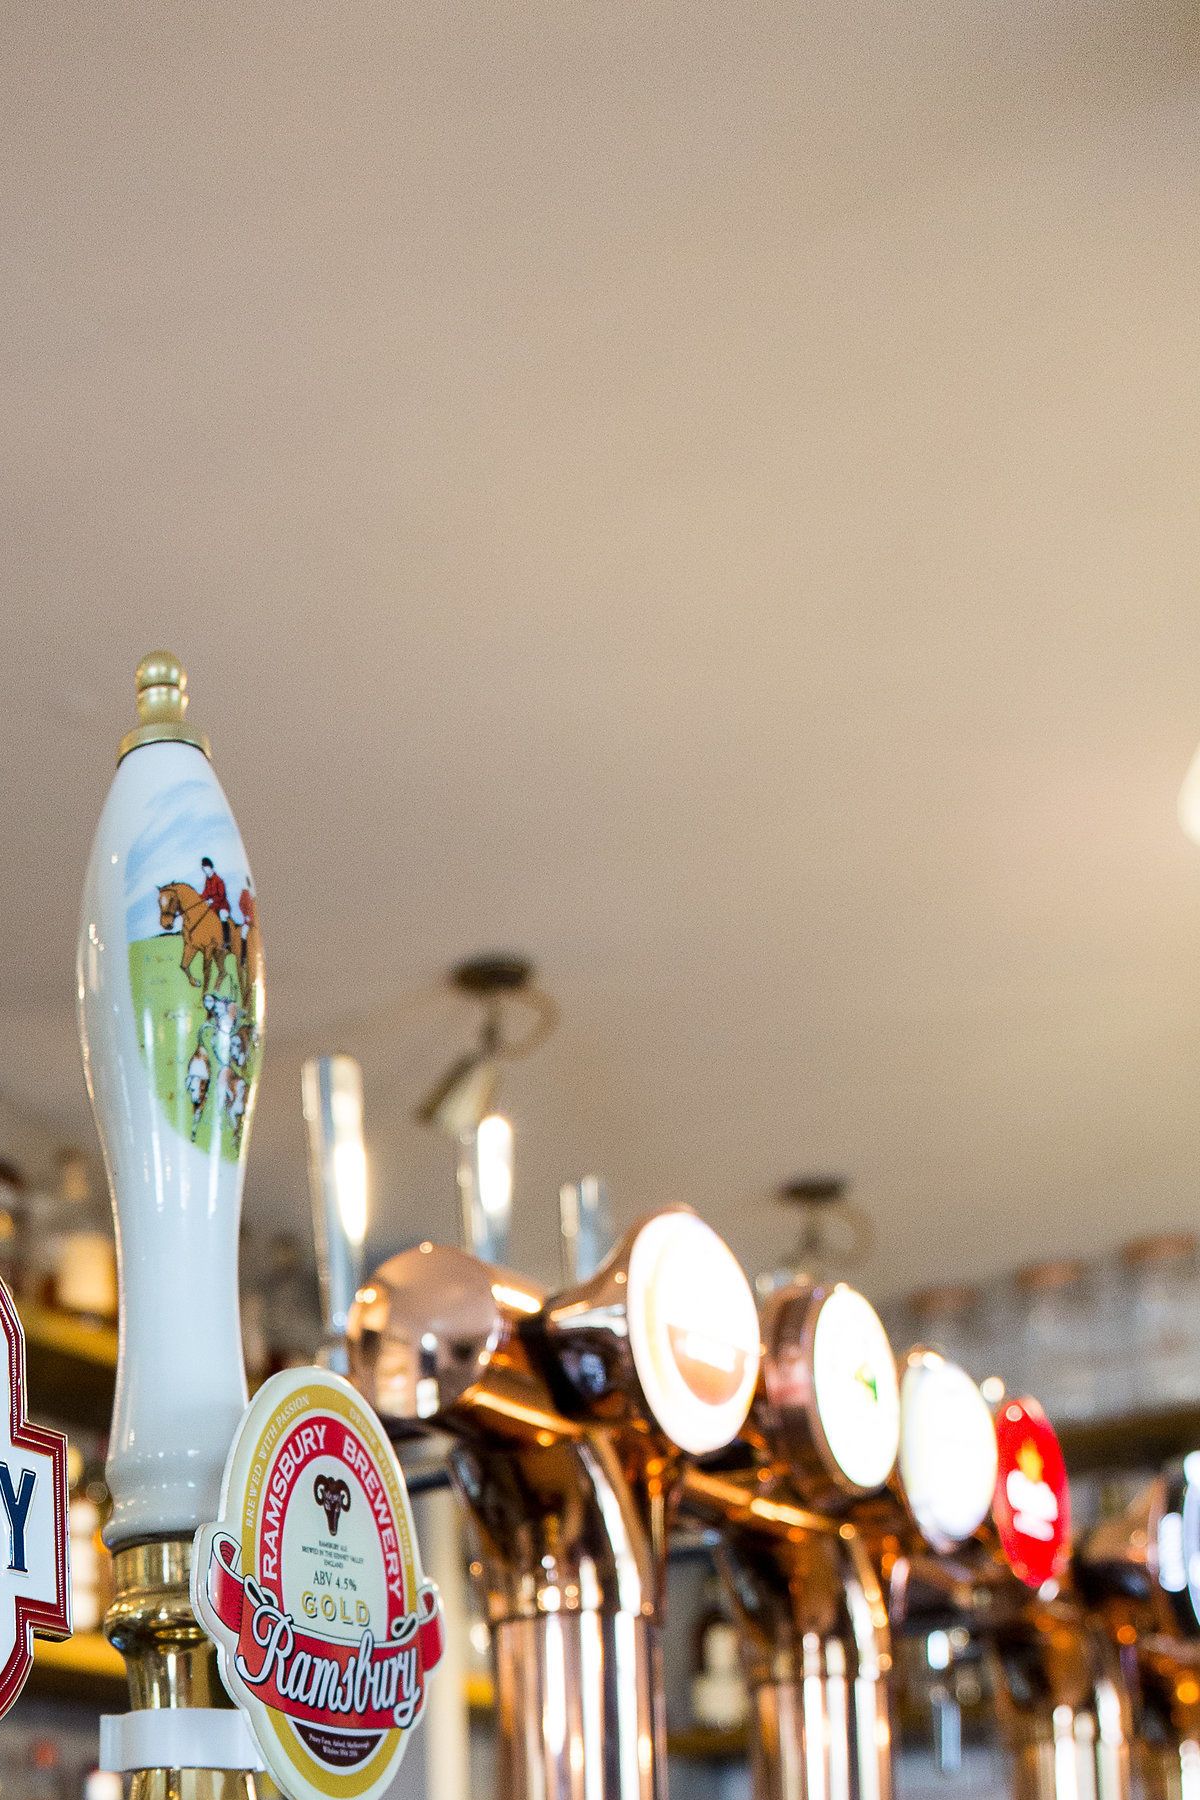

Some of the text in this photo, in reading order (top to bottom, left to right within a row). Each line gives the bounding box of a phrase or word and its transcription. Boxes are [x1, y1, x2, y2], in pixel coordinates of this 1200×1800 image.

[246, 1394, 310, 1528] BREWED WITH PASSION
[262, 1424, 327, 1580] RAMSBURY
[341, 1434, 402, 1599] BREWERY
[301, 1590, 370, 1627] GOLD
[313, 1570, 357, 1591] ABV 4.5%
[234, 1604, 421, 1729] Ramsbury
